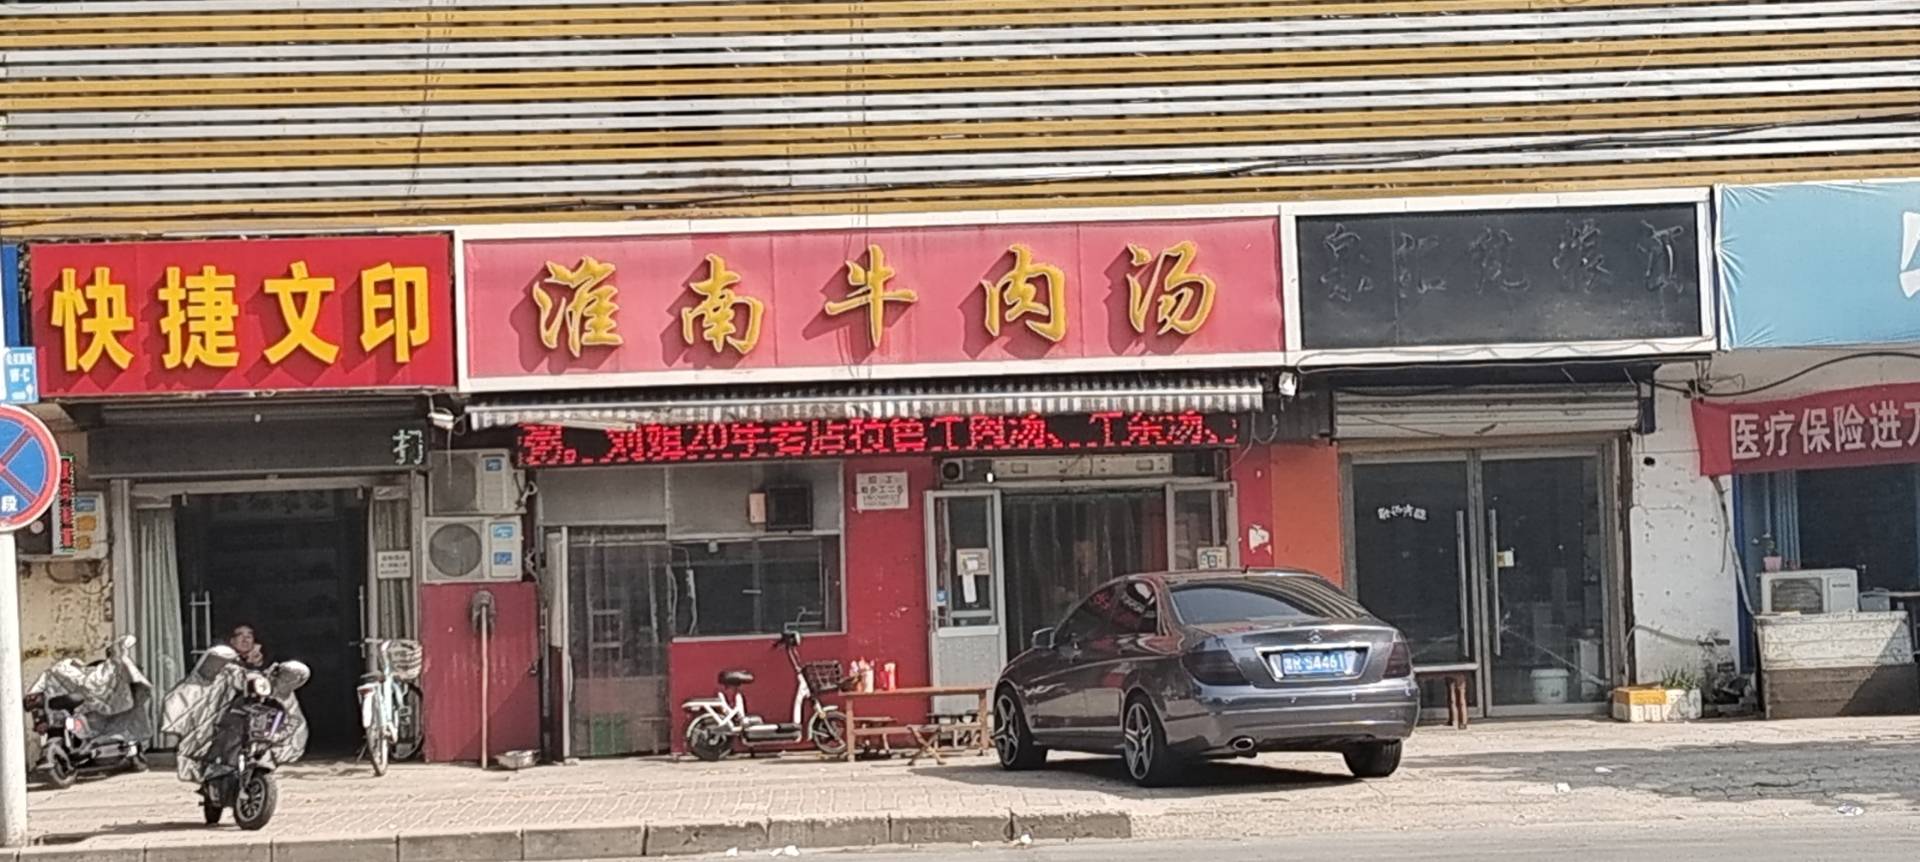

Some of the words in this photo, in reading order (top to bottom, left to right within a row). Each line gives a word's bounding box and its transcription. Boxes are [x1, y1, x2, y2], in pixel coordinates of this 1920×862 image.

[51, 262, 430, 372] 快捷文印
[532, 240, 1217, 357] 淮南牛肉汤
[392, 429, 424, 465] 打
[1, 495, 18, 512] 段
